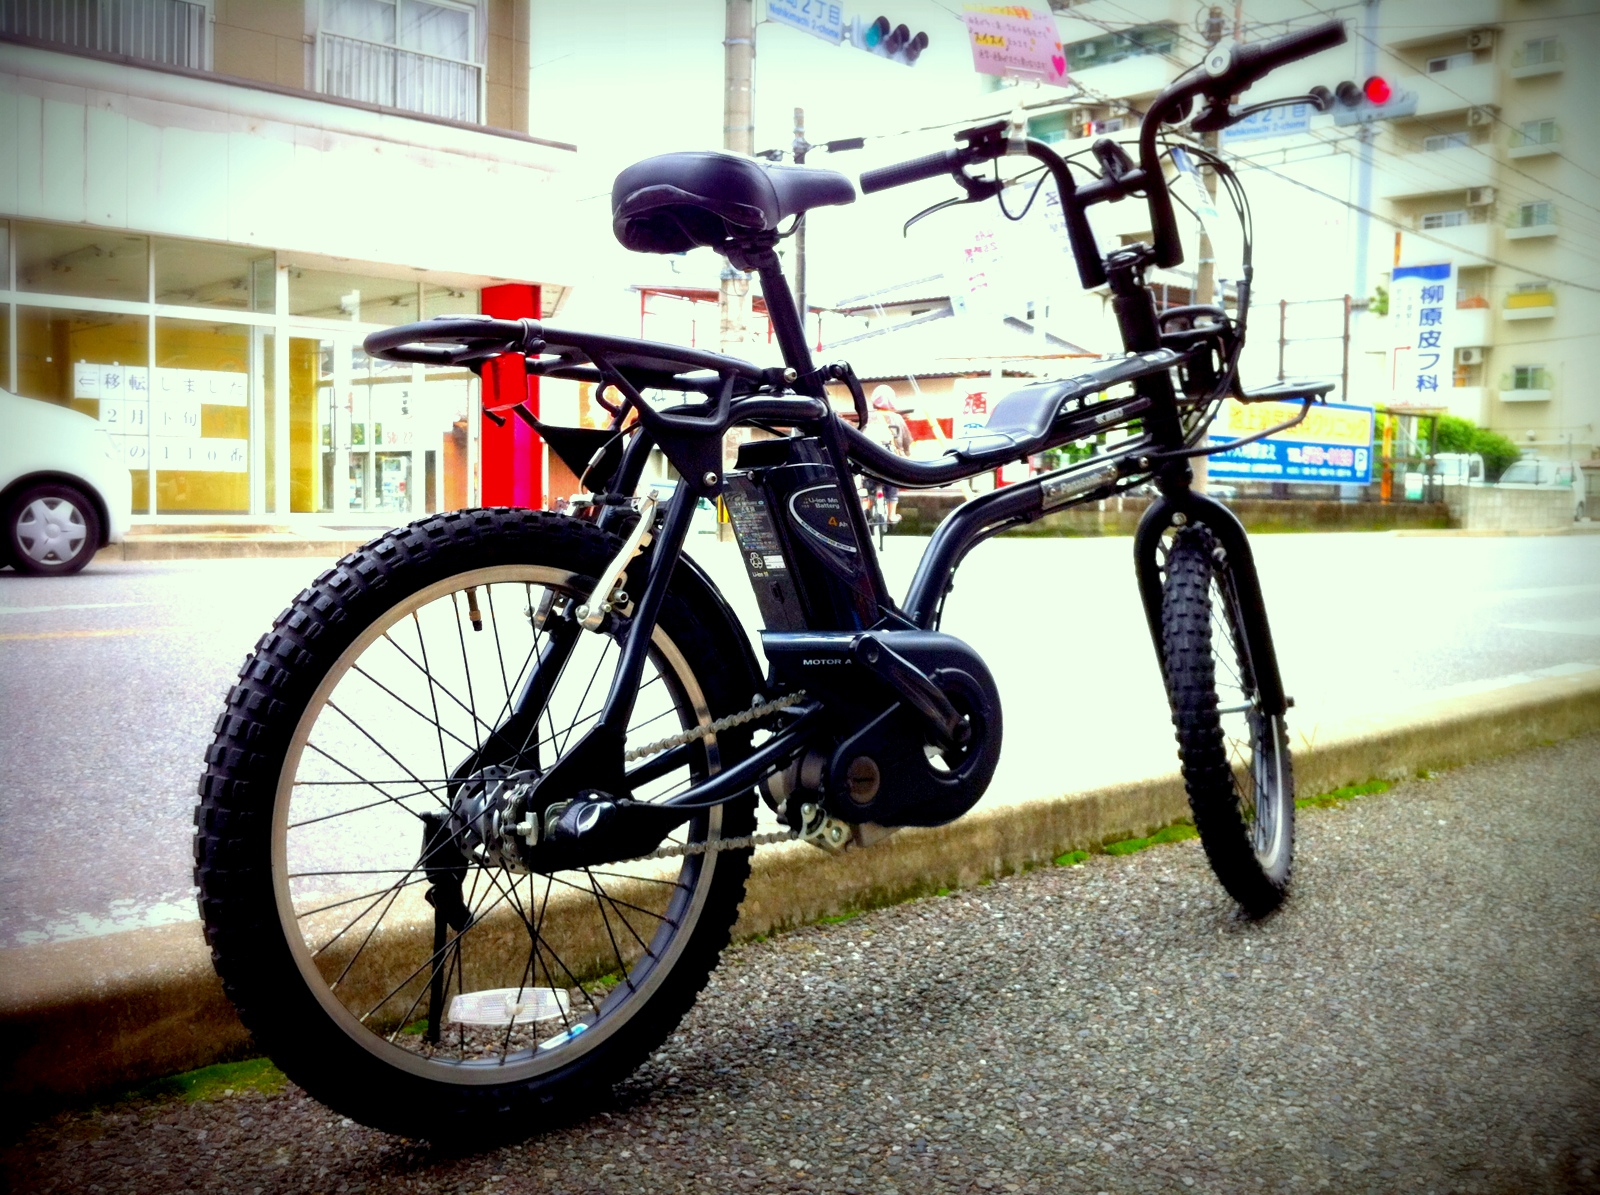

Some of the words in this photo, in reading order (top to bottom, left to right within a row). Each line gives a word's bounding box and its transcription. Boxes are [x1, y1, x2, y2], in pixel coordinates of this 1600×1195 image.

[1416, 285, 1444, 392] 柳原皮フ科
[103, 372, 243, 396] 移転しました
[828, 516, 838, 527] 4
[803, 658, 842, 666] MOTOR
